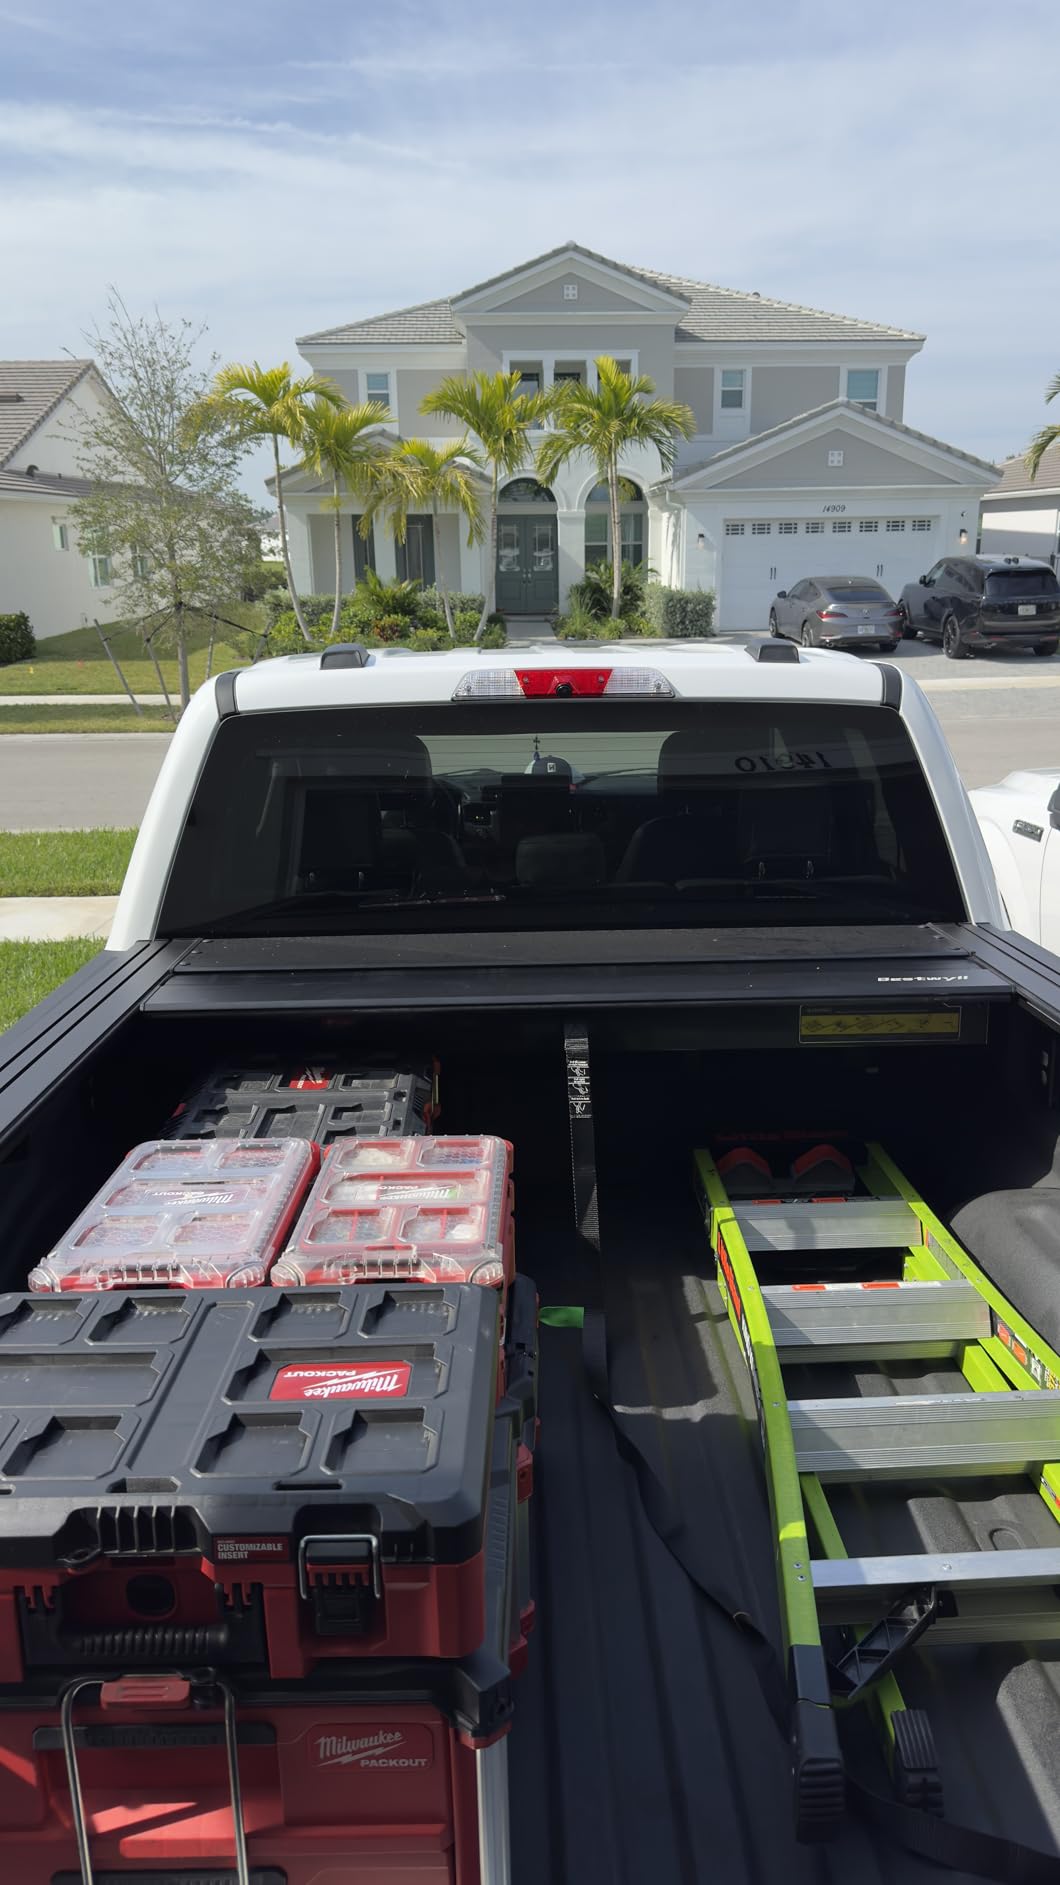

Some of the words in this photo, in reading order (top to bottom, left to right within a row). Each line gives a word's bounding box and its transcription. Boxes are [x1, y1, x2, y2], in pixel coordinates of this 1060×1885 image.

[822, 504, 846, 513] 14909
[283, 1370, 356, 1378] PACKOUT
[303, 1374, 403, 1398] Milwaukee
[217, 1543, 283, 1551] CUSTOMIZABLE
[217, 1551, 248, 1559] INSERT
[314, 1730, 403, 1760] Milwaukee
[360, 1758, 427, 1768] PACKOUT
